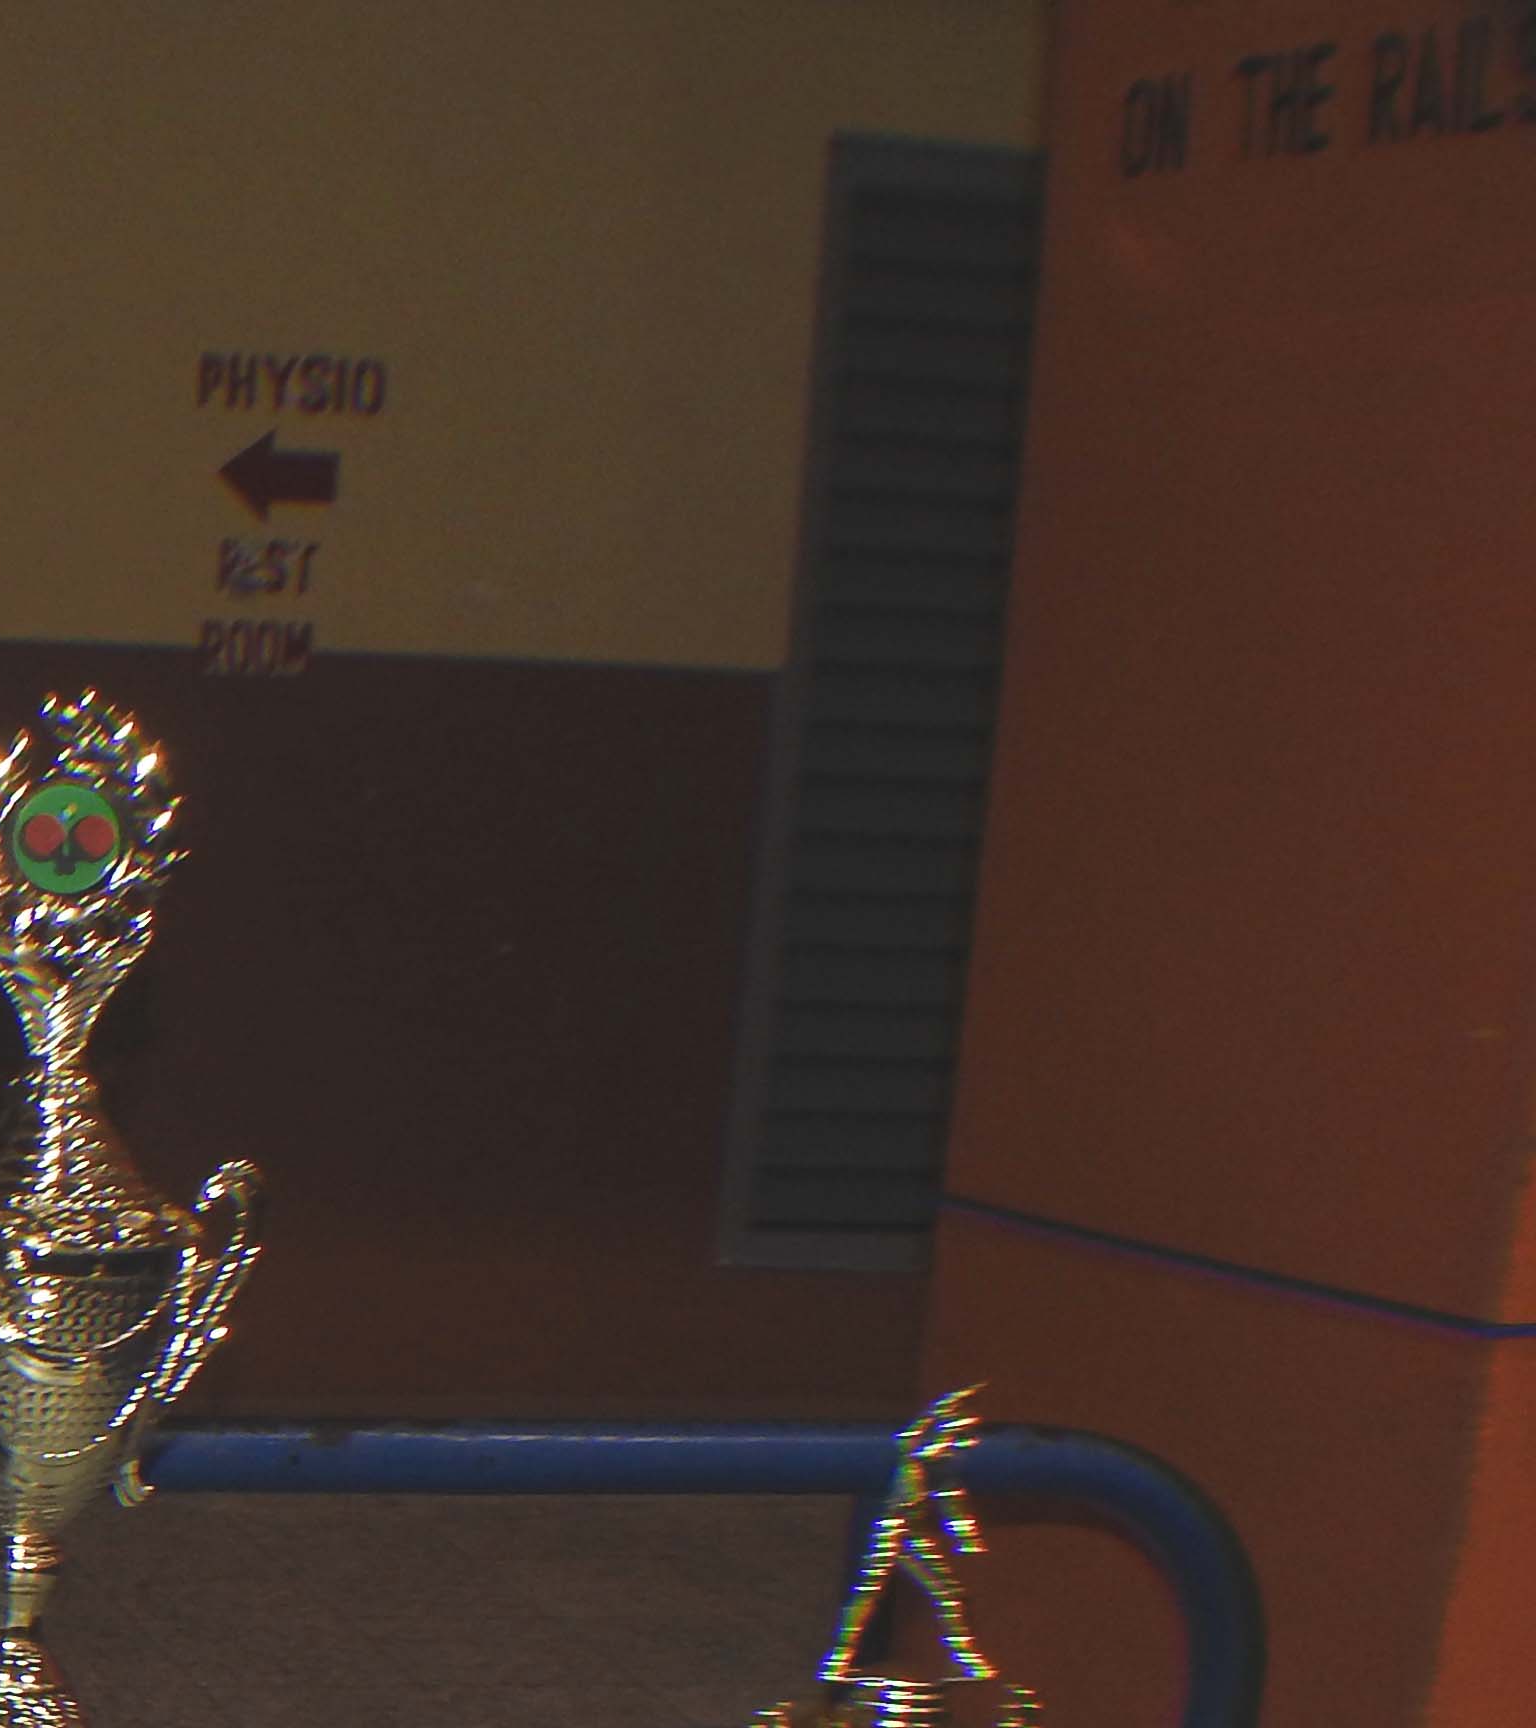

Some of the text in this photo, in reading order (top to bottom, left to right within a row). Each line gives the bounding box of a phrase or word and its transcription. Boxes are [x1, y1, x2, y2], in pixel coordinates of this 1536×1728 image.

[1122, 74, 1193, 178] ON
[1234, 42, 1336, 160] THE
[197, 352, 387, 415] PHYSIO
[197, 617, 313, 677] ROOM
